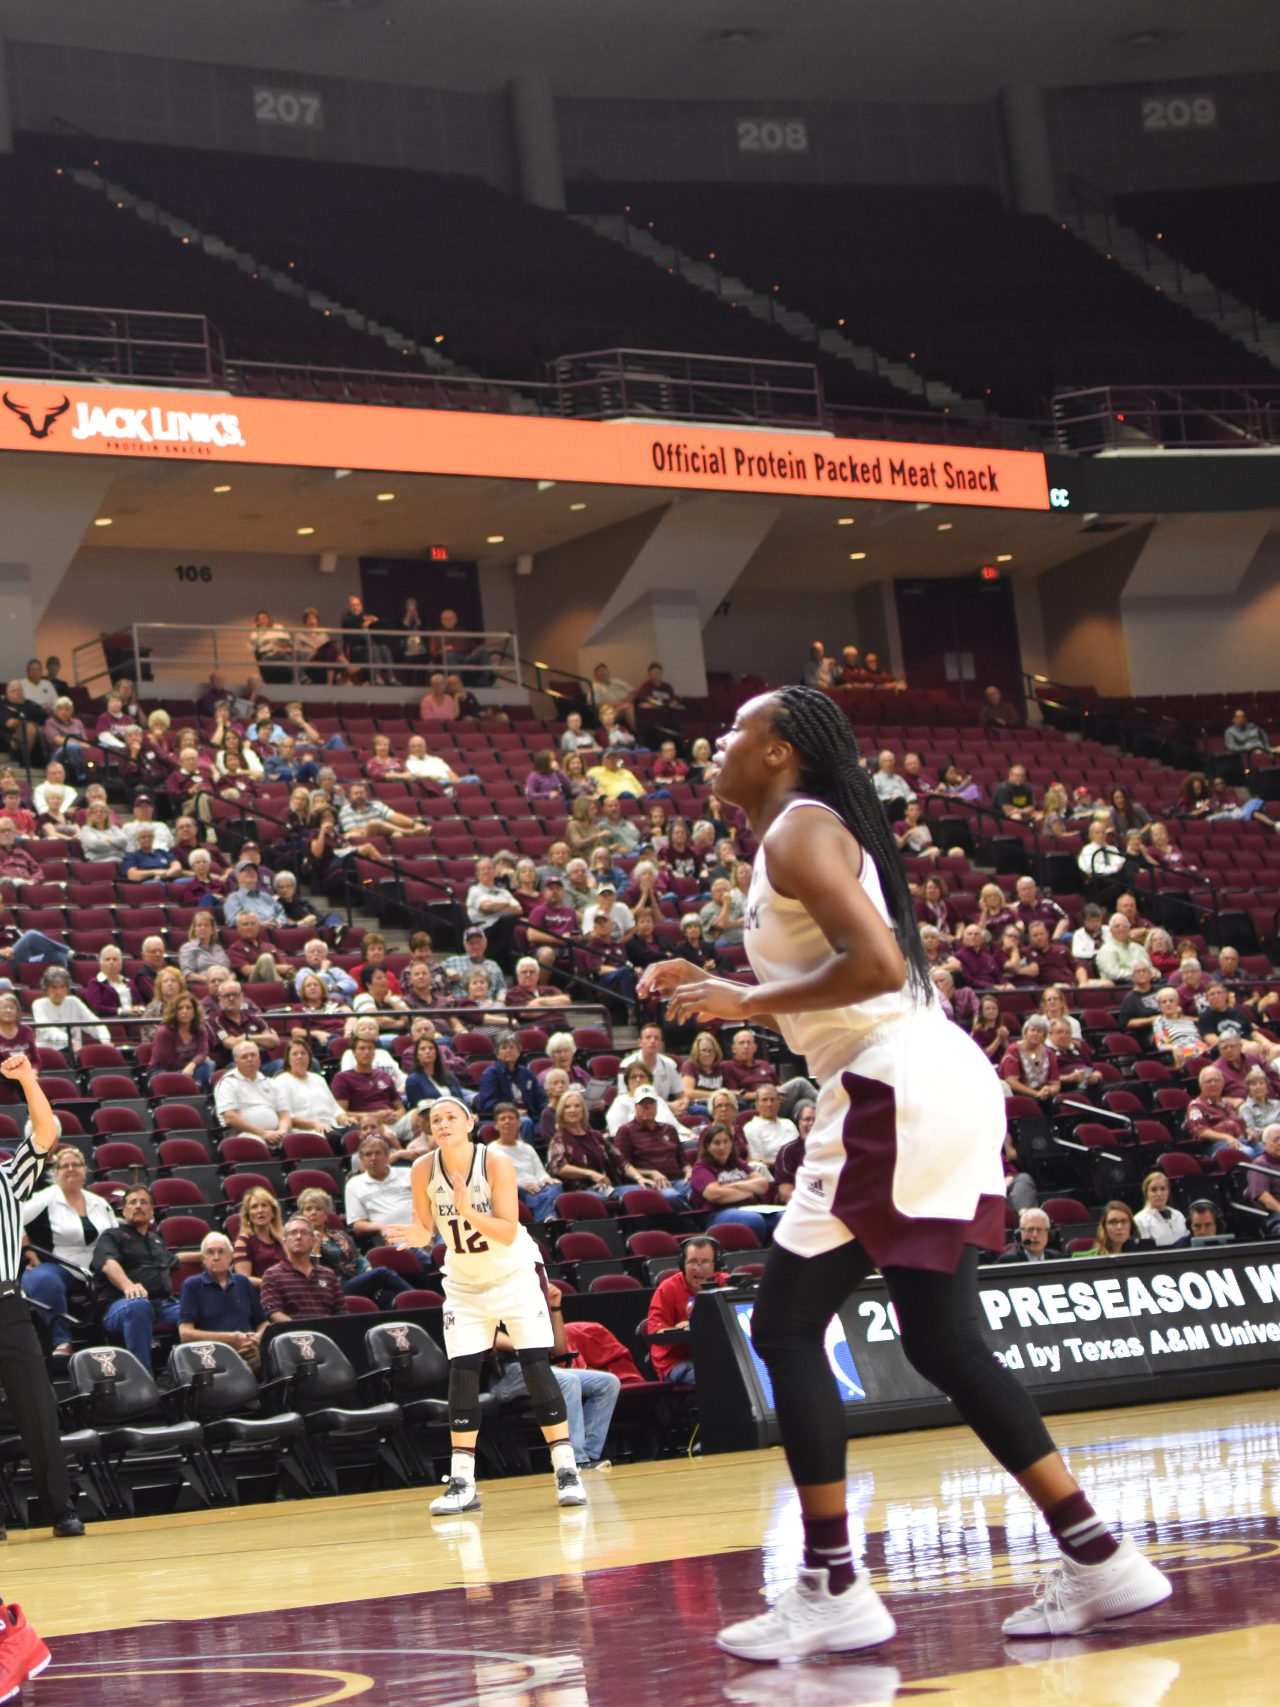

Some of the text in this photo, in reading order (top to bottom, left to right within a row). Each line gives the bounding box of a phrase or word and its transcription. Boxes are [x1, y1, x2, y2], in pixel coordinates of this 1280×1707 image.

[255, 91, 320, 125] 207
[1143, 100, 1217, 129] 209
[737, 122, 809, 153] 208
[72, 401, 153, 443] JACK
[107, 441, 211, 456] PROTEIN SNACKS
[652, 441, 1000, 493] Official Protein Packed Meat Snack
[175, 565, 213, 582] 106
[447, 1218, 489, 1255] 12
[978, 1267, 1246, 1331] PRESEASON
[1027, 1343, 1061, 1373] by
[1063, 1336, 1145, 1363] Texas
[1150, 1325, 1210, 1355] A&M
[1210, 1319, 1280, 1347] Unive
